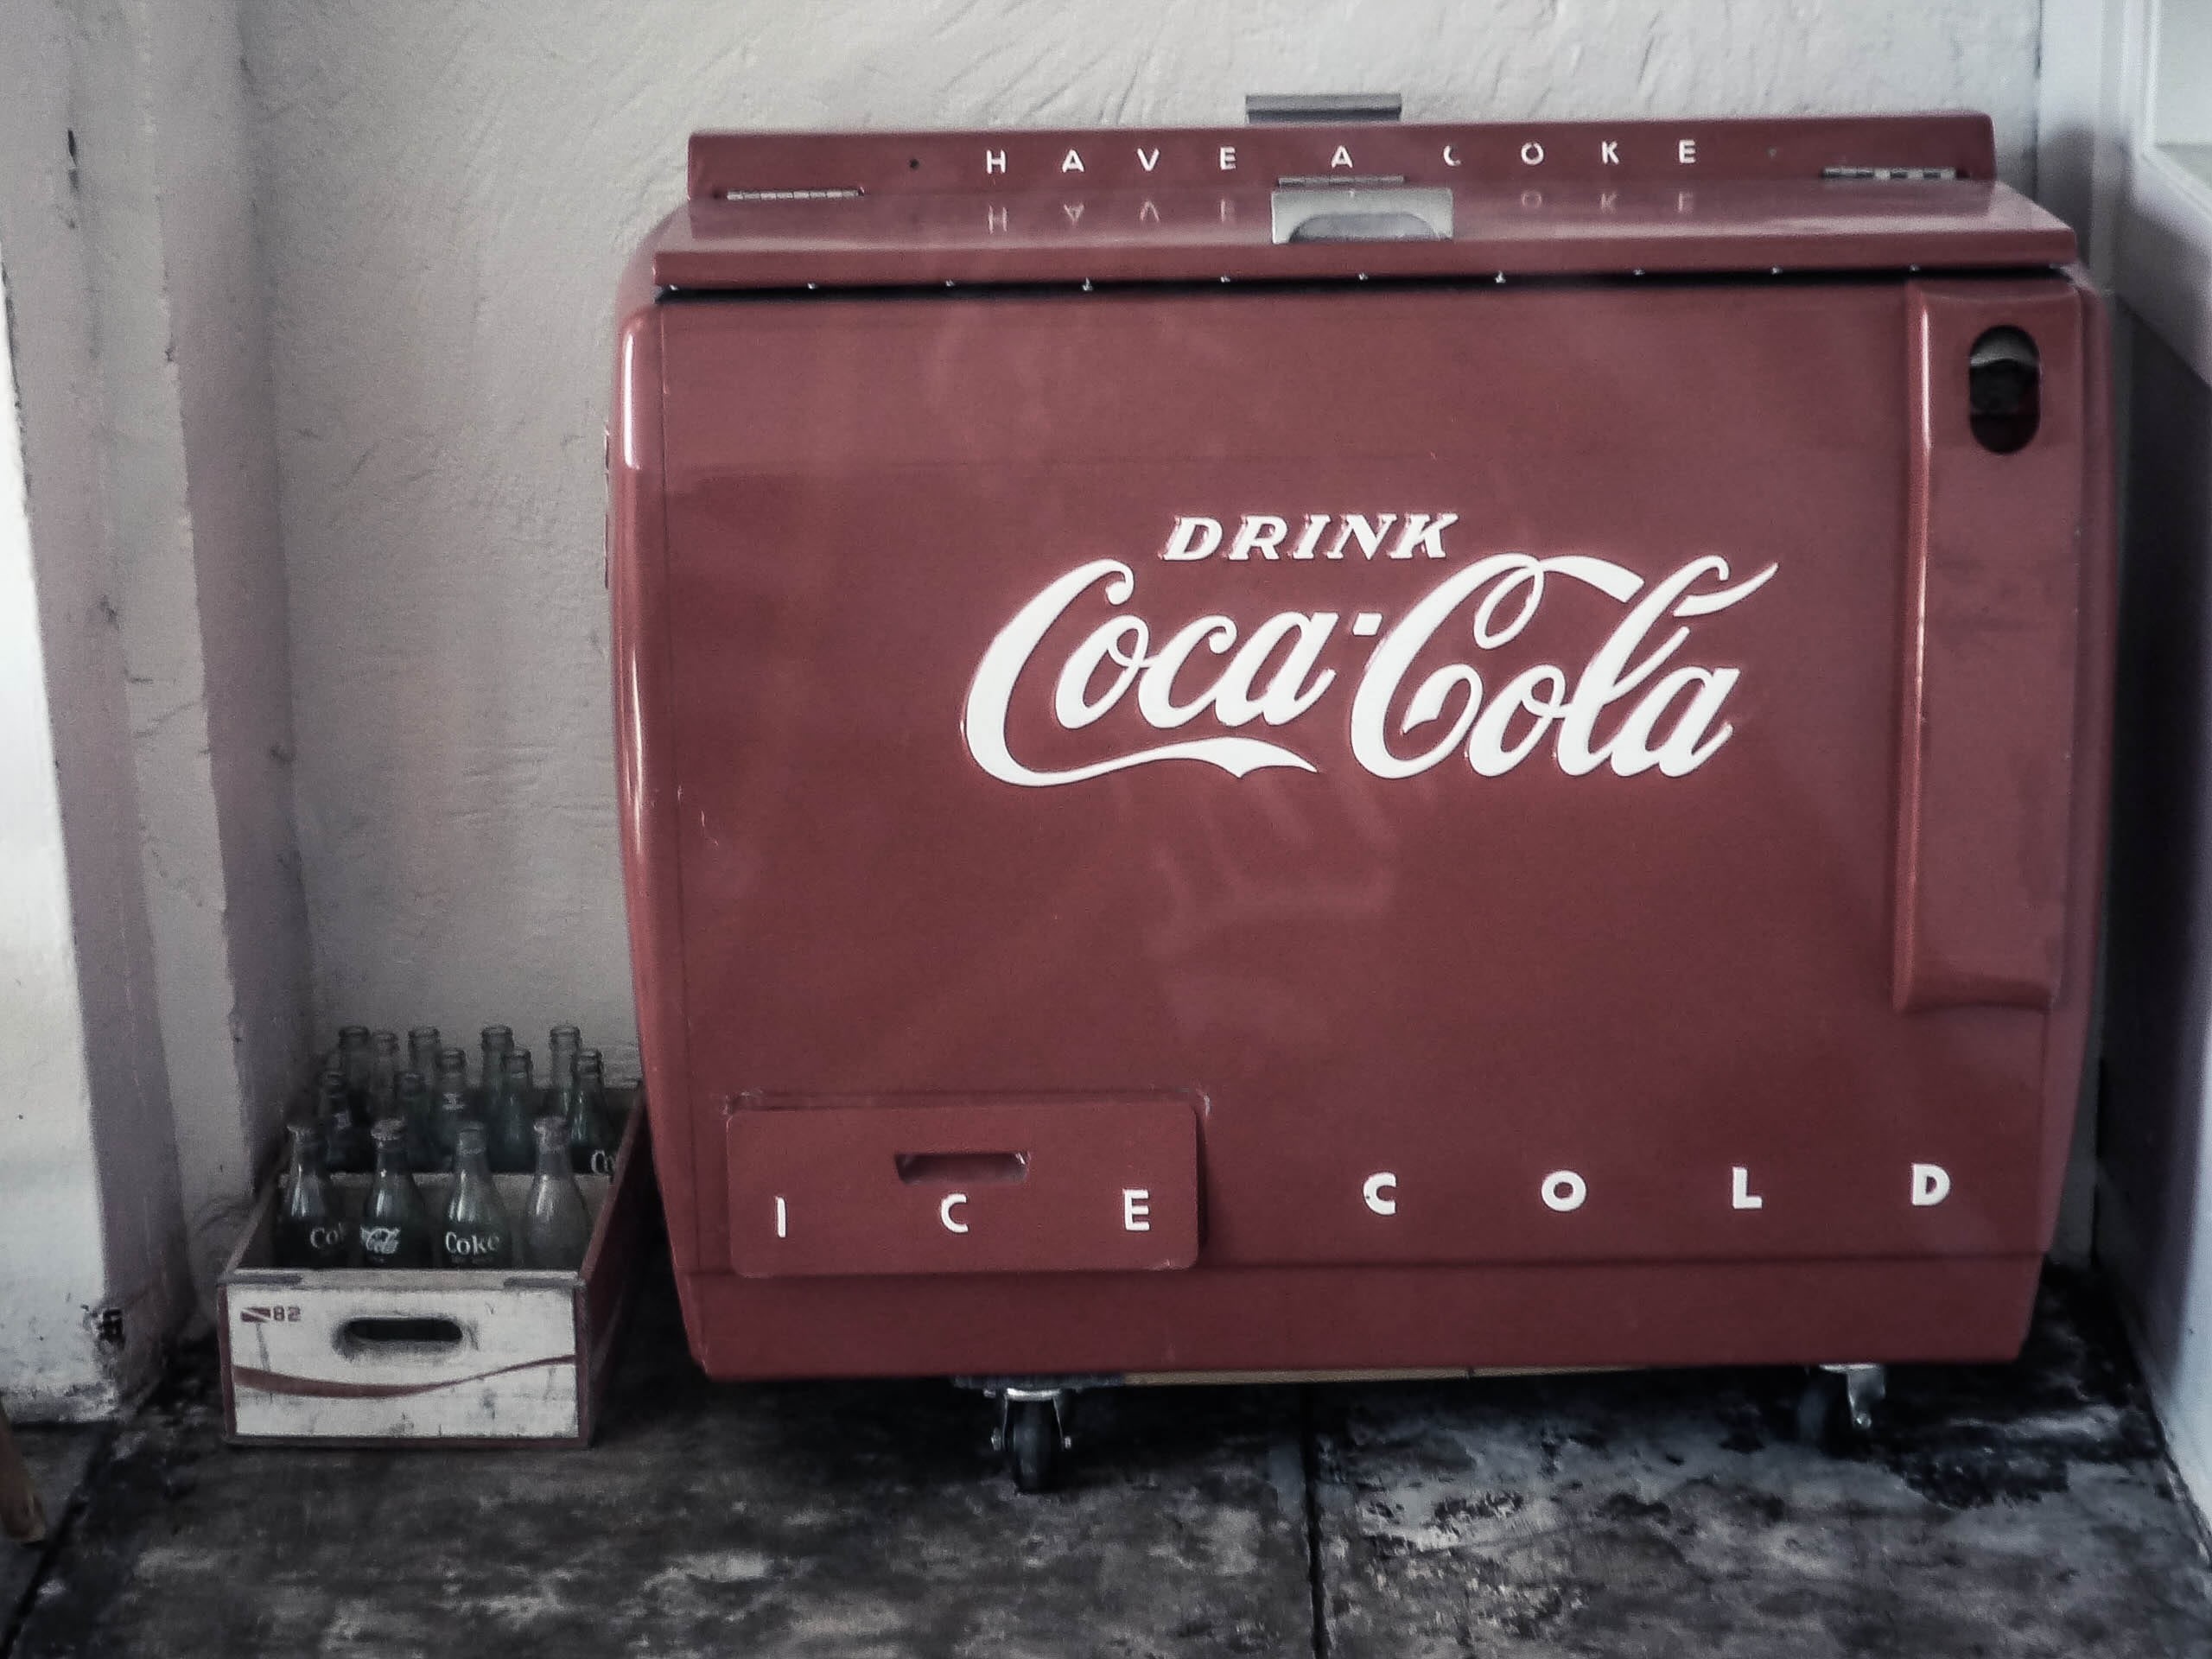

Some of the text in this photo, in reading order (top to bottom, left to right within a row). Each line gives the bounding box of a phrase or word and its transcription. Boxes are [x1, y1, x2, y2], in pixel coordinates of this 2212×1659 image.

[986, 146, 1236, 175] HAVE
[1331, 144, 1353, 168] A
[1157, 512, 1459, 561] DRINK
[962, 551, 1778, 787] Coca-Cola
[775, 1162, 1950, 1237] ICE COLD
[446, 1230, 499, 1255] Coke
